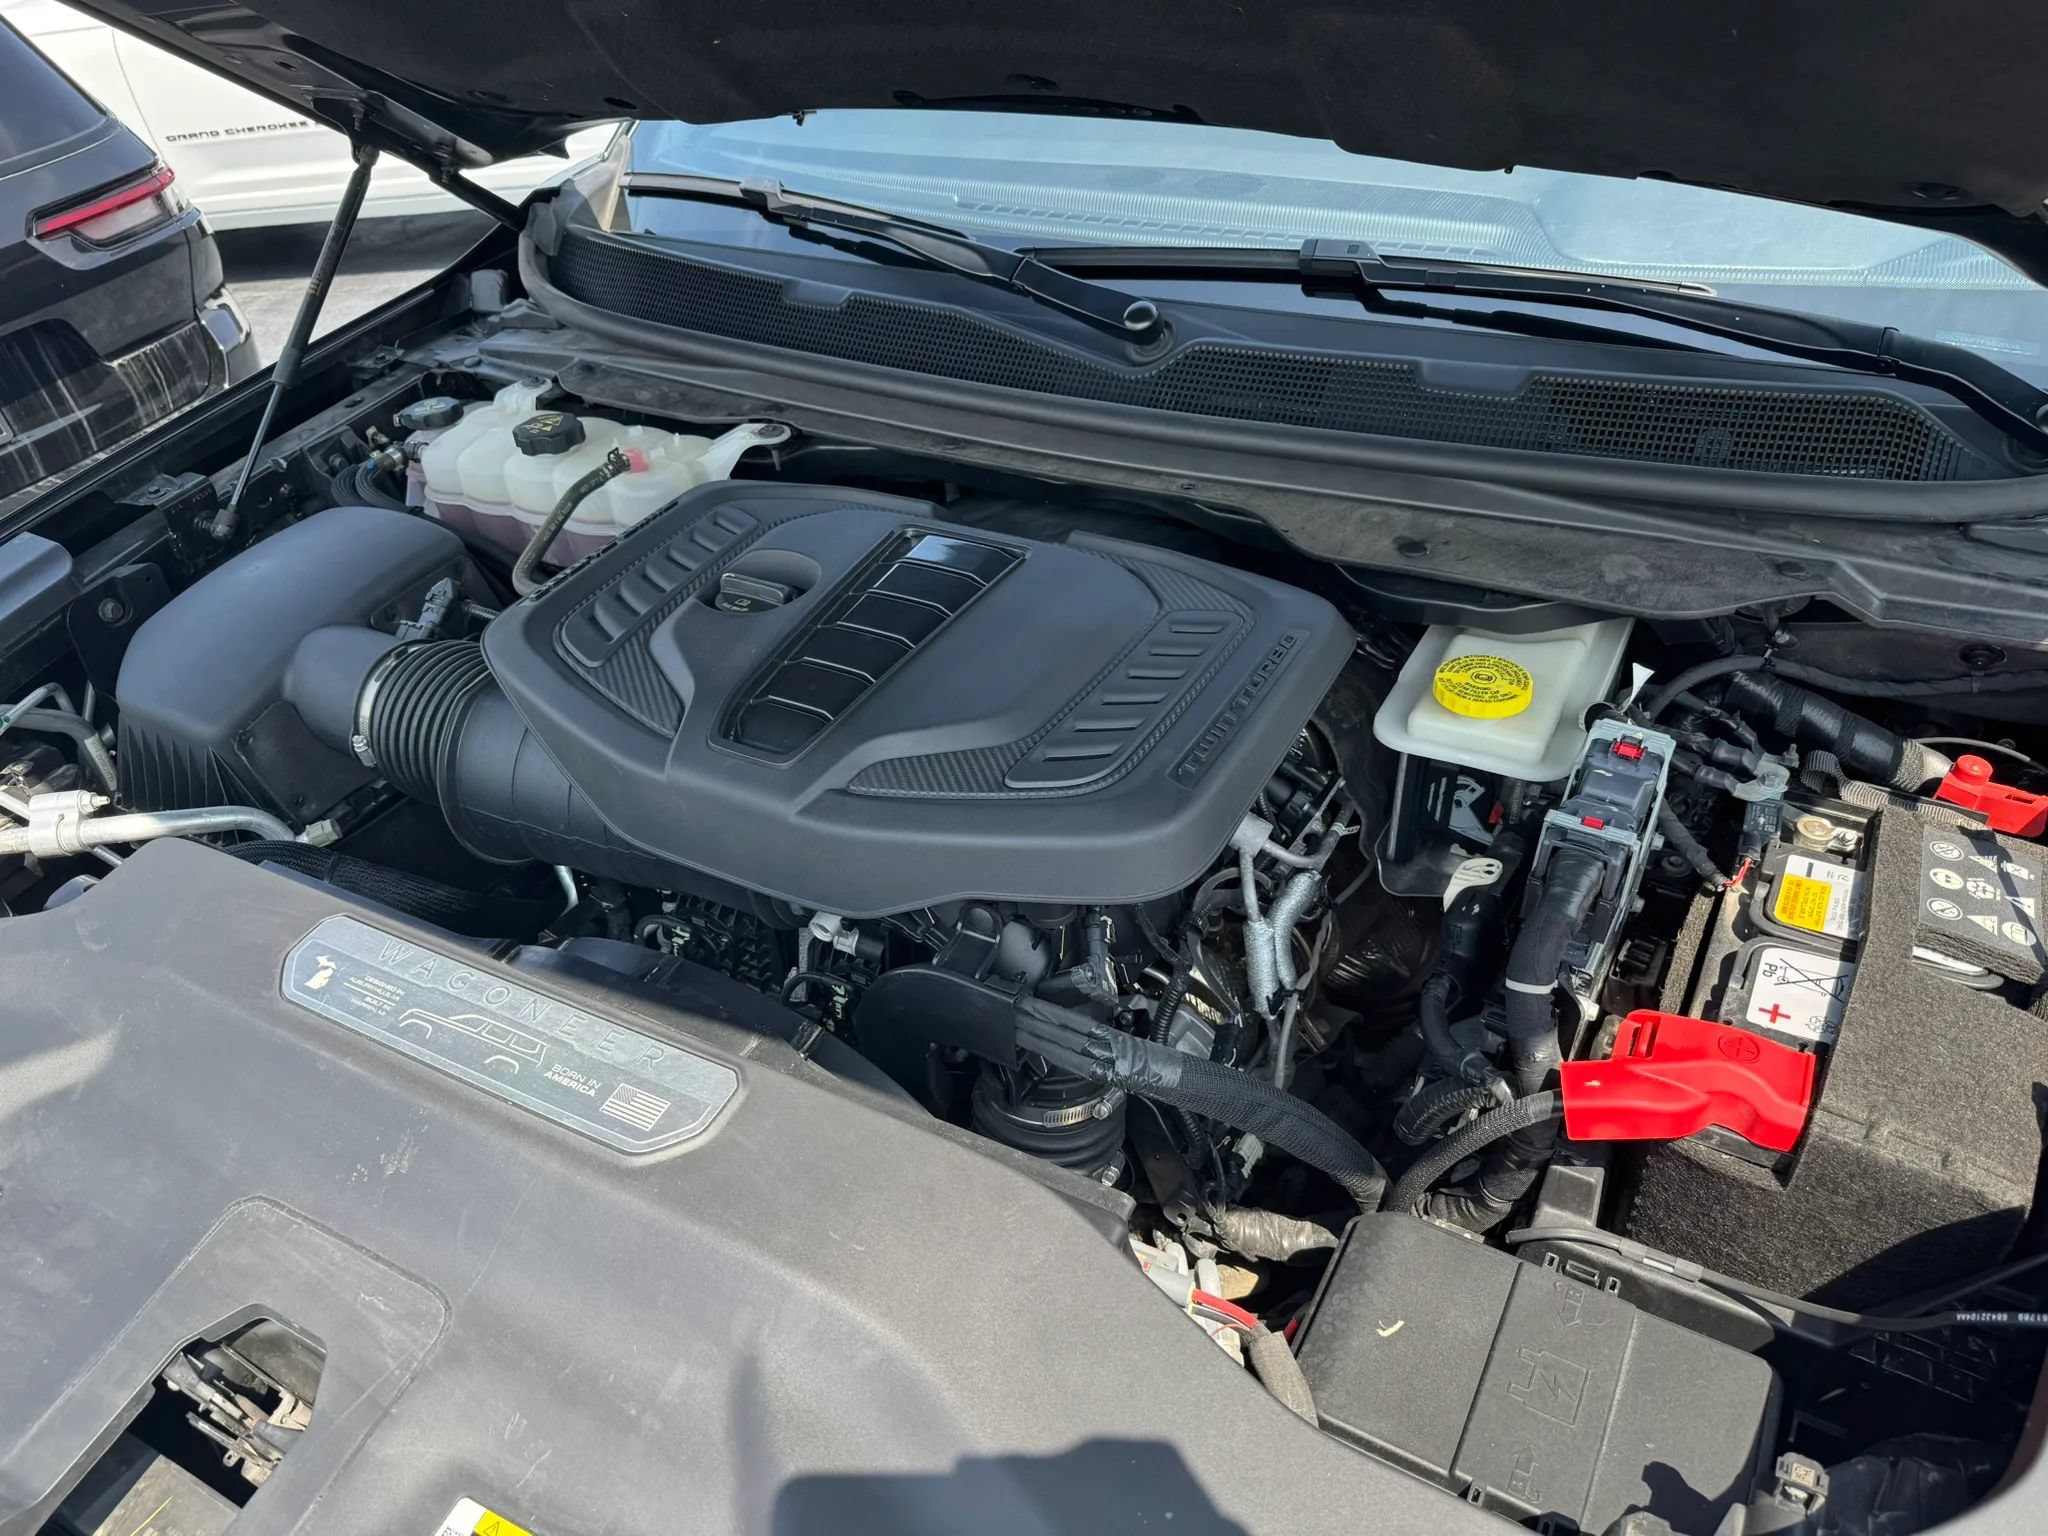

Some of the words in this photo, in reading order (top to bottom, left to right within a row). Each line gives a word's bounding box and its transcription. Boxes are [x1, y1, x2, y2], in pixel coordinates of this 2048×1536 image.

[166, 130, 220, 142] GRAND
[225, 121, 310, 136] CHEROKEE
[1177, 711, 1237, 775] TWIN
[1231, 634, 1297, 714] TURBO
[1762, 962, 1778, 978] Pb
[379, 940, 665, 1069] WAGONEER
[543, 1070, 596, 1097] AMERICA
[551, 1063, 587, 1083] BORN
[587, 1078, 602, 1090] IN
